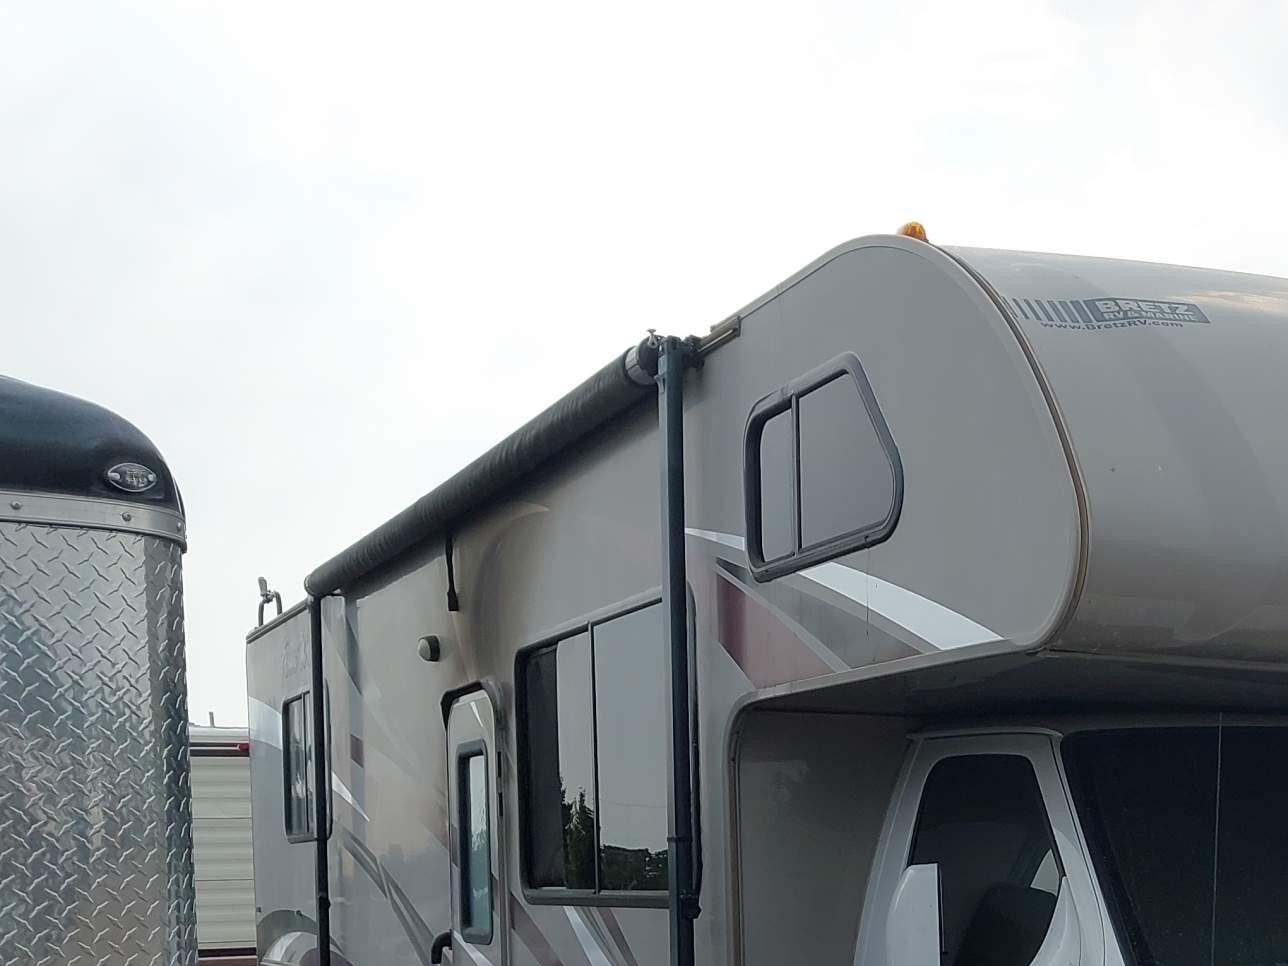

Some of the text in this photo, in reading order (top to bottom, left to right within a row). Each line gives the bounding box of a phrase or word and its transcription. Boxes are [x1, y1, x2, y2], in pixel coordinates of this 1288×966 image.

[1095, 299, 1194, 315] BRETZ
[1102, 311, 1125, 320] RV
[1142, 311, 1199, 321] MARINE
[1040, 319, 1184, 331] www.BretzRV.com
